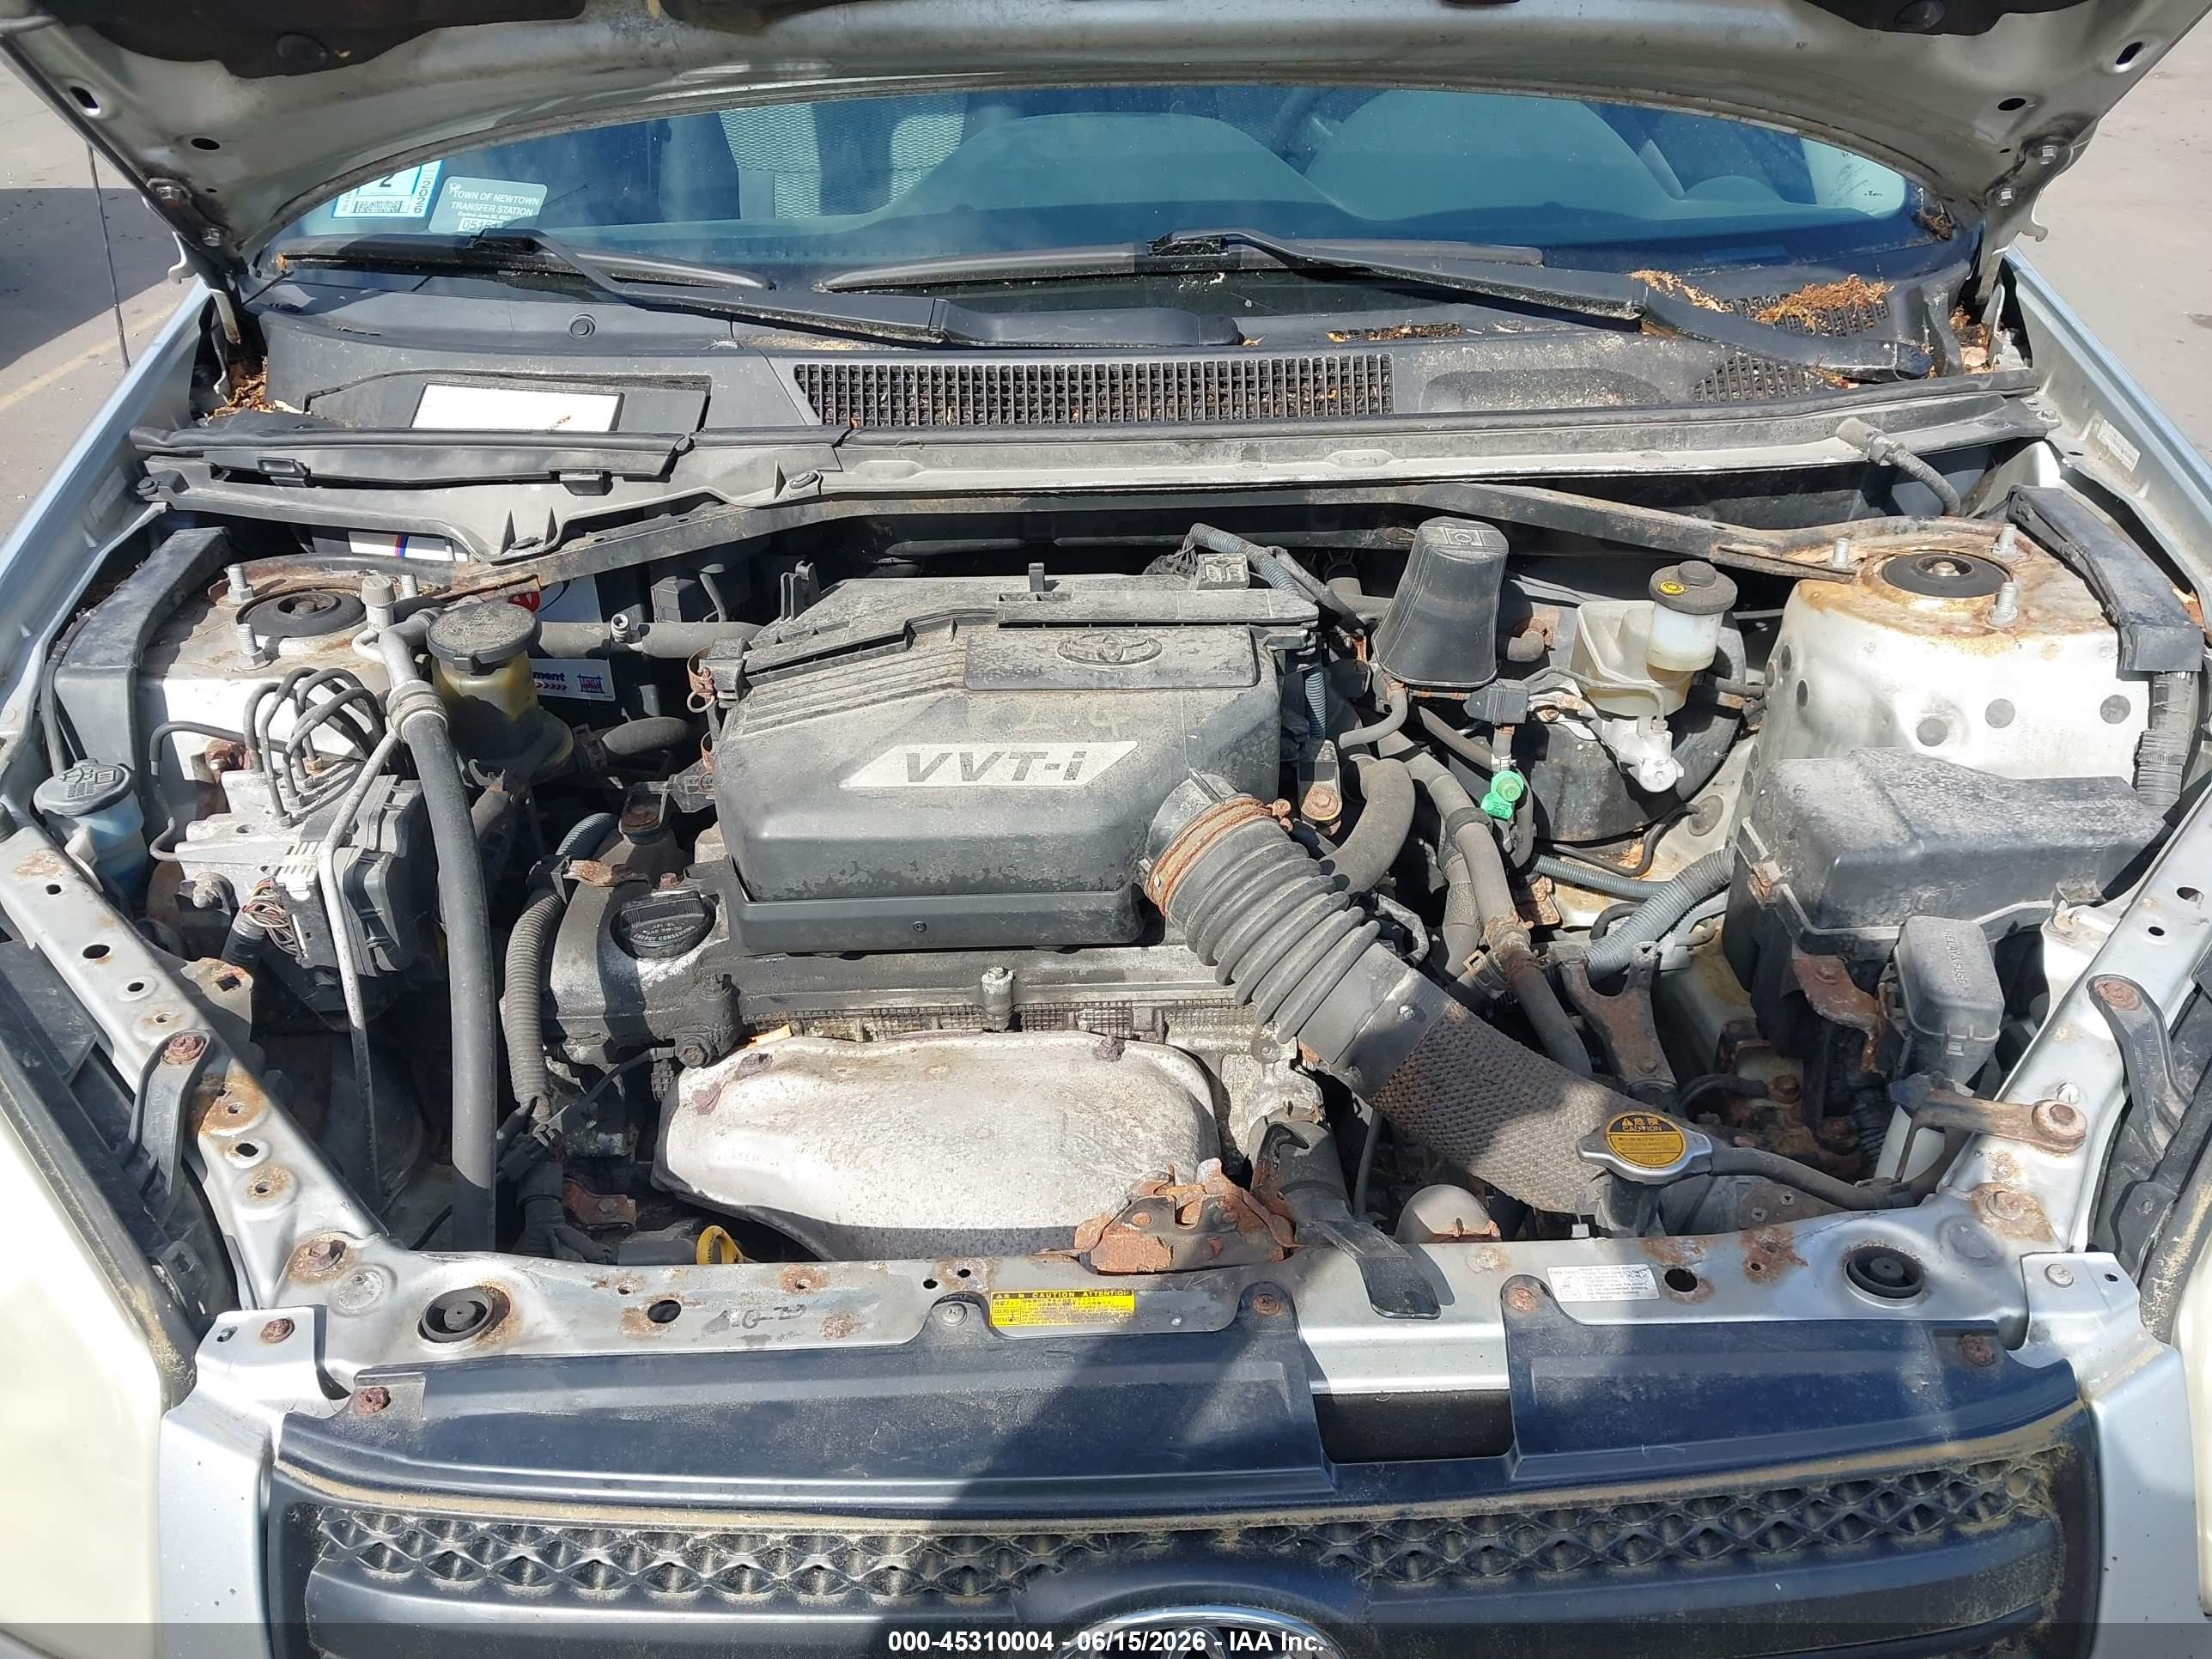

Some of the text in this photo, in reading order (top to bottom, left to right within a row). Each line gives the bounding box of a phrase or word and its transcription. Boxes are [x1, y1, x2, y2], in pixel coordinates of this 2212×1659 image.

[413, 180, 431, 214] 2026
[451, 201, 533, 216] TRANSFER STATION
[453, 190, 540, 205] TOWN OF NEWTOWN
[906, 751, 1087, 783] VVT-i
